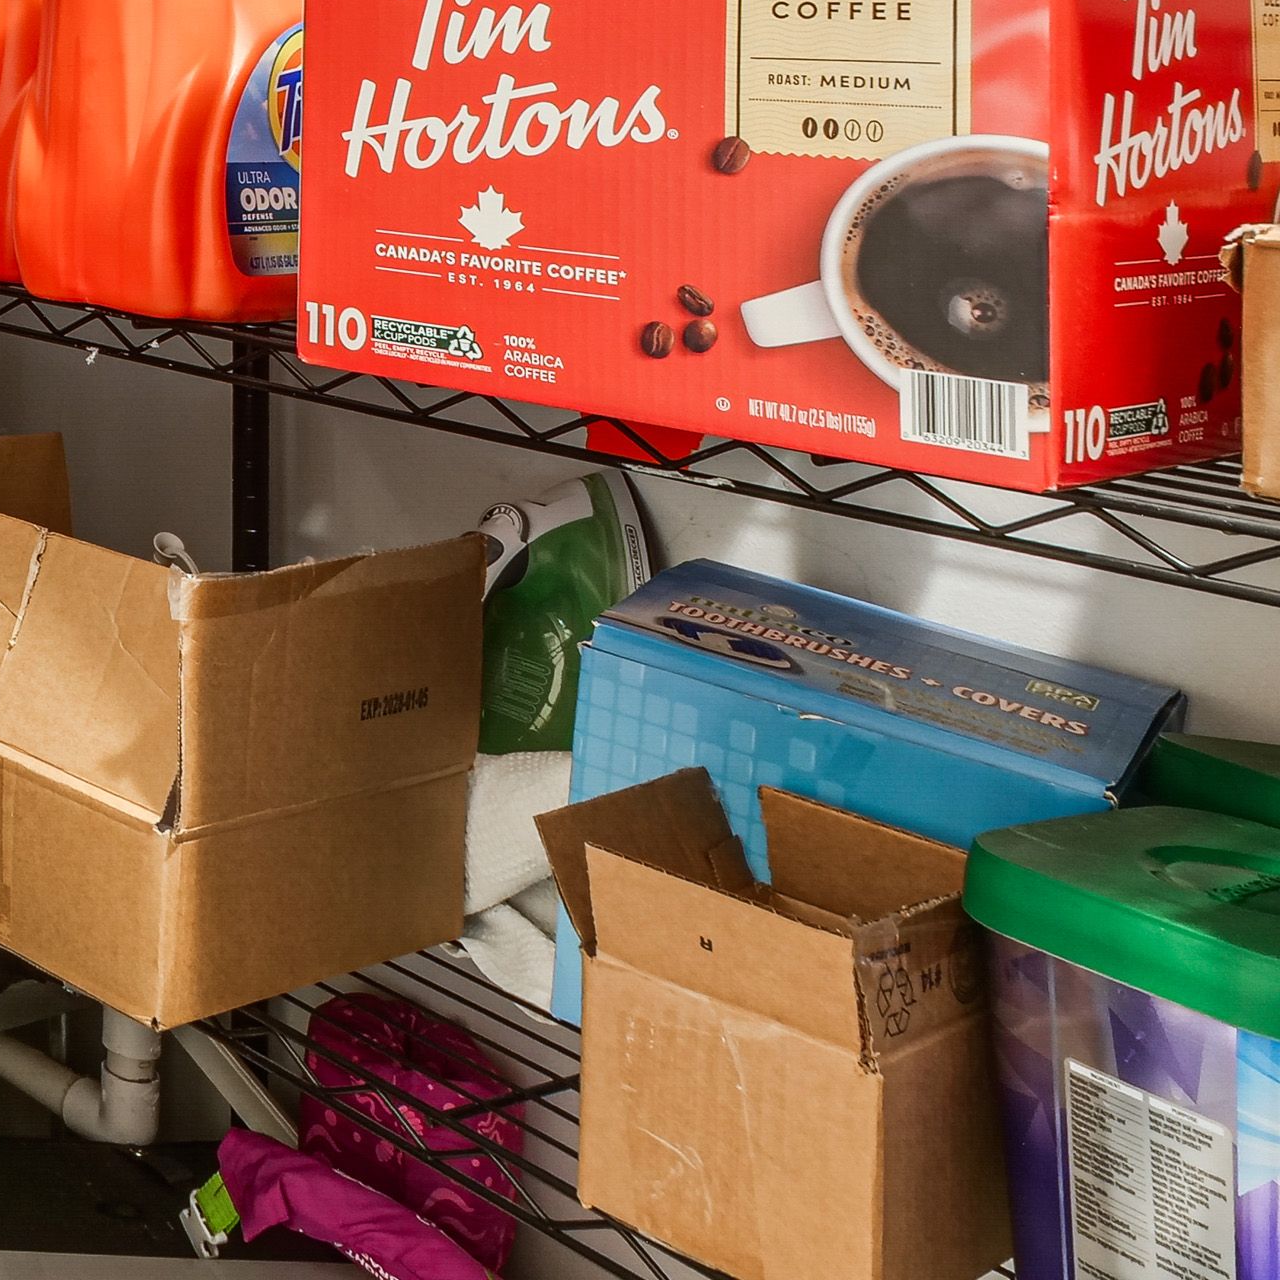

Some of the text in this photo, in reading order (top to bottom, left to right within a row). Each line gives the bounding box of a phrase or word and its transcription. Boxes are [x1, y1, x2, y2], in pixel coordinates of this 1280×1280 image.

[771, 1, 912, 21] COFFEE
[768, 73, 912, 91] ROAST: MEDIUM
[341, 73, 667, 178] Hortons
[1094, 82, 1243, 207] Hortons
[237, 170, 271, 185] ULTRA
[240, 187, 298, 212] ODOR
[242, 213, 273, 221] DEFENSE
[244, 223, 272, 233] ADVANCED
[272, 223, 287, 232] ODOR
[460, 253, 542, 276] FAVORITE
[448, 271, 535, 293] EST. 1964
[1158, 272, 1196, 288] FAVORITE
[1152, 296, 1169, 307] EST.
[306, 301, 368, 351] 110
[408, 334, 437, 347] PODS
[503, 334, 536, 350] 100%
[503, 350, 564, 370] ARABICA
[504, 365, 556, 384] COFFEE
[749, 398, 876, 438] NET WT 40.7 oz (2.5 lbs) (1155g)
[1179, 410, 1208, 426] ARABICA
[1064, 405, 1106, 464] 110
[1178, 428, 1204, 443] COFFEE
[669, 600, 912, 681] TOOTHBRUSHES
[921, 677, 944, 688] +
[952, 686, 1090, 736] COVERS
